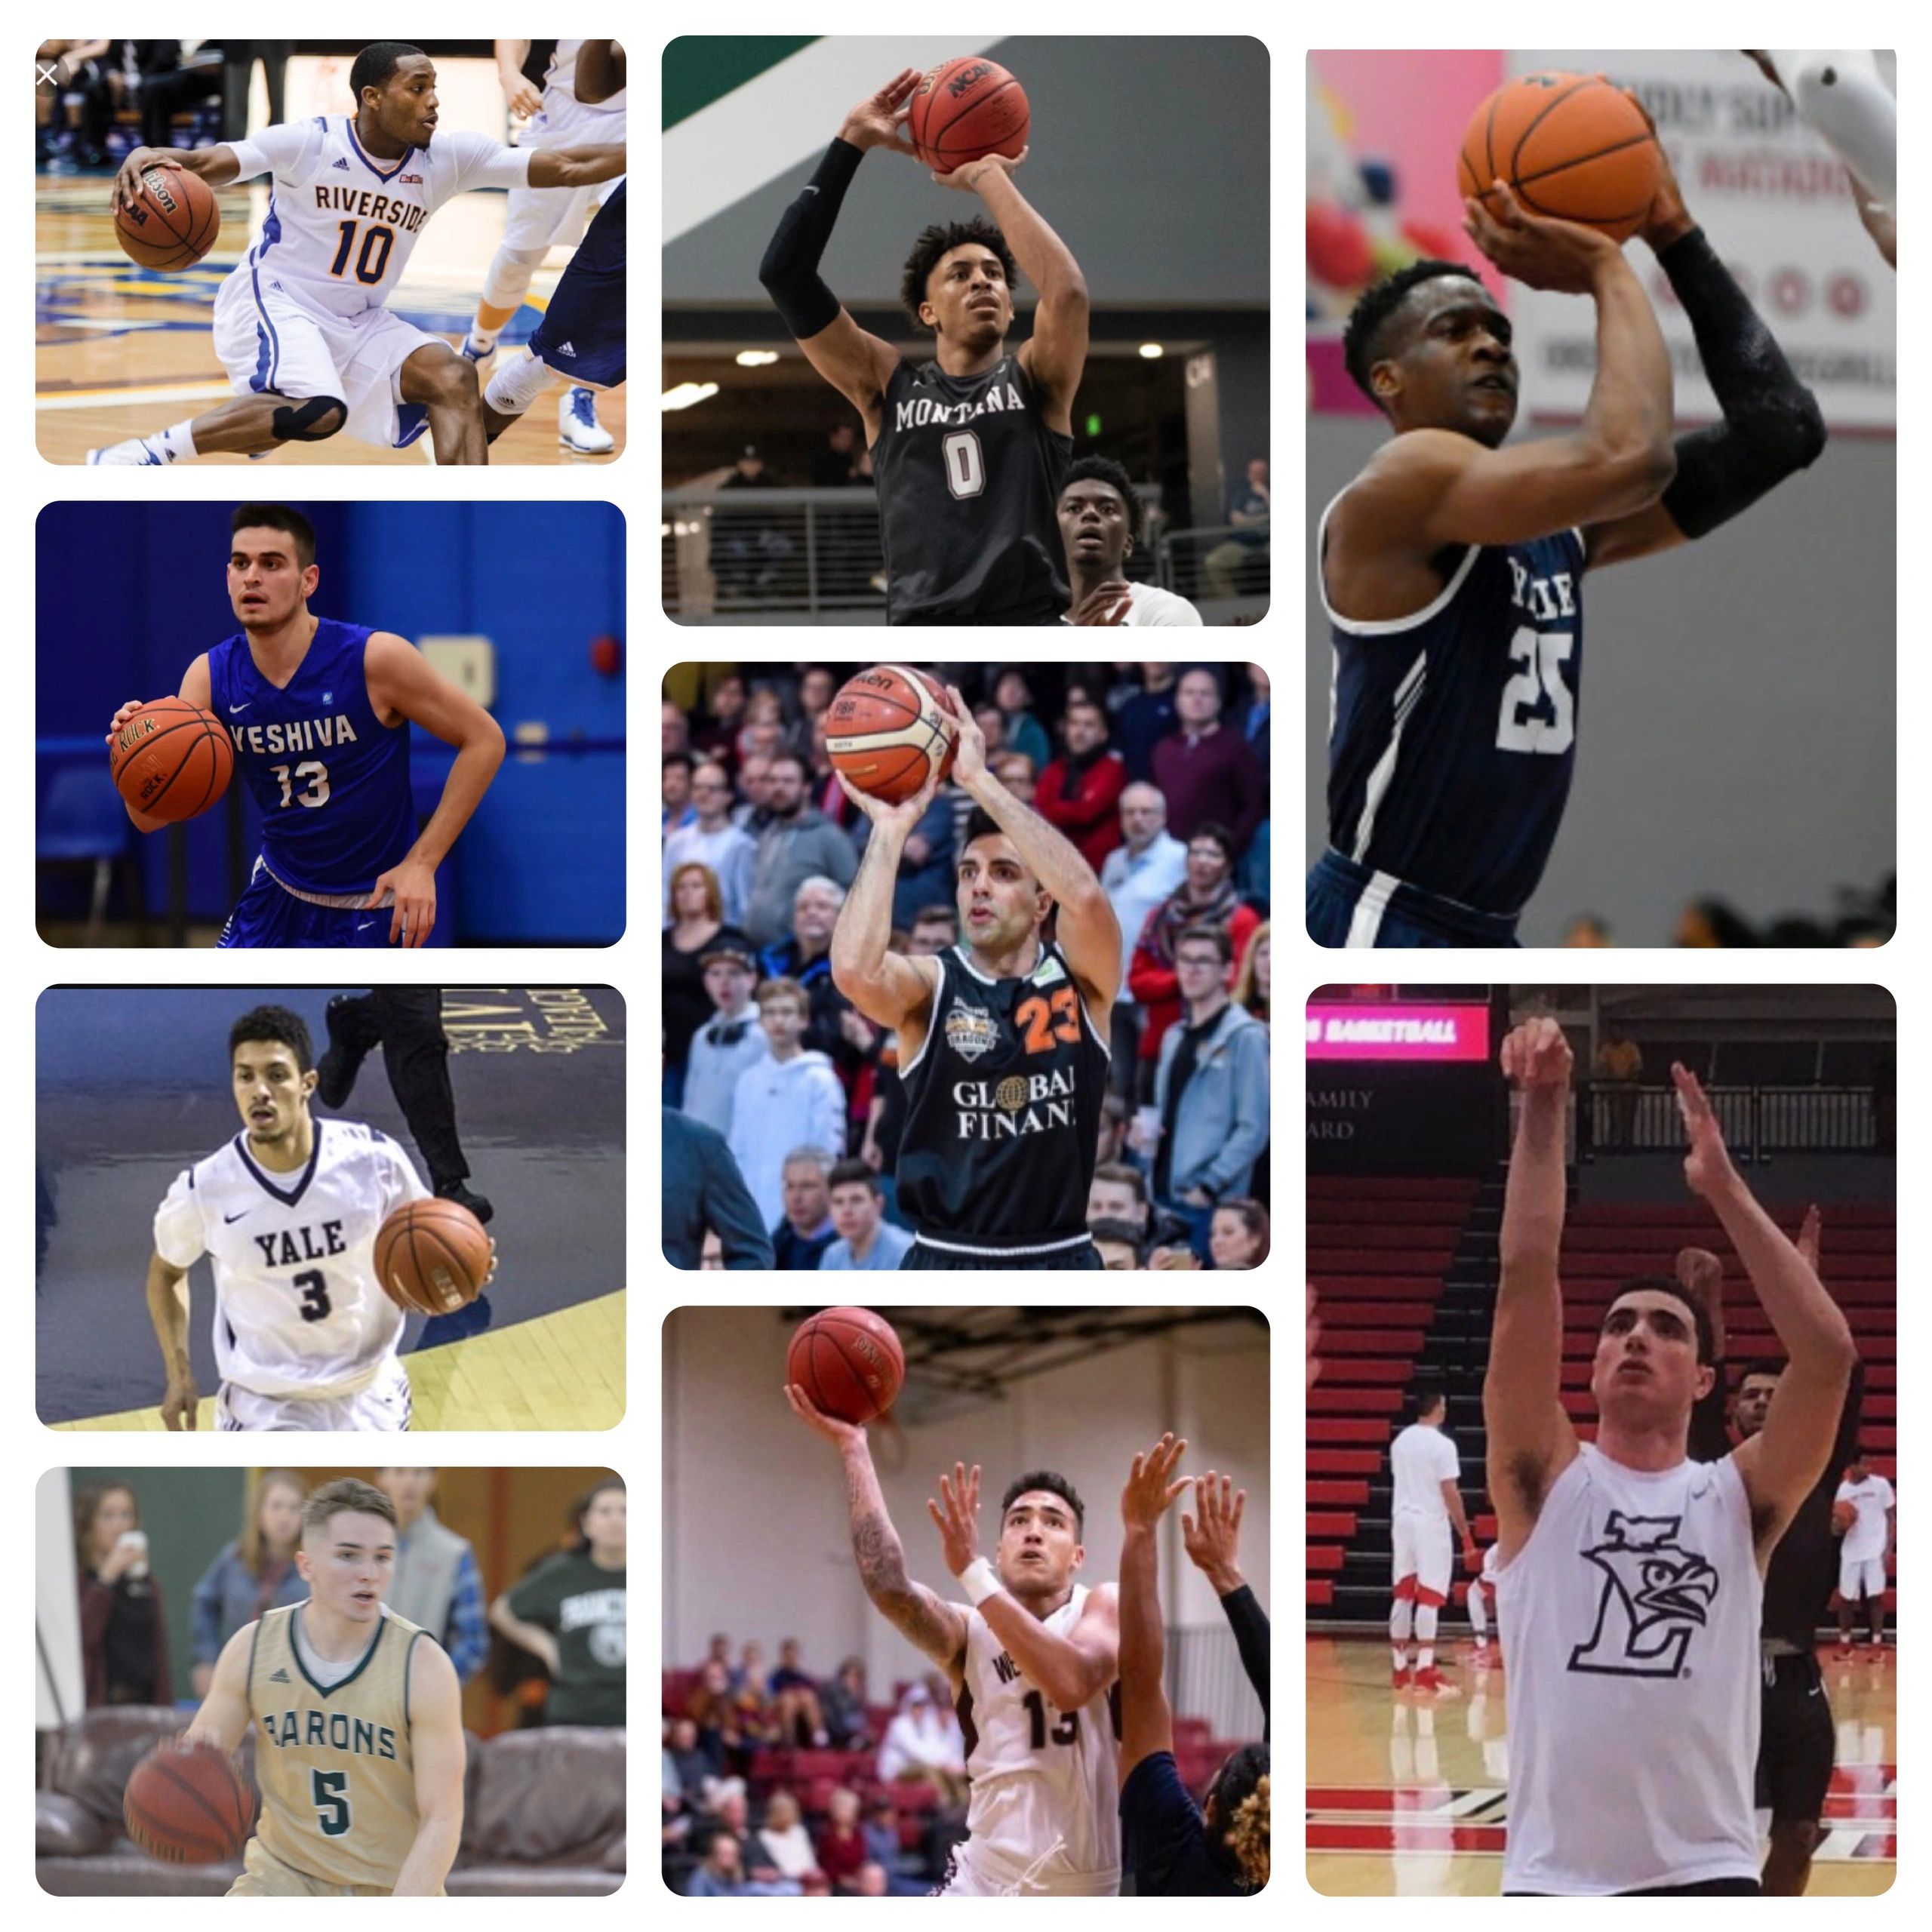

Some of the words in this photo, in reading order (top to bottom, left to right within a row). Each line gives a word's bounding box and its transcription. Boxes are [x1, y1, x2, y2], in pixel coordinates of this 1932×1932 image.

[142, 169, 178, 216] ilson
[330, 220, 396, 286] 10
[941, 429, 986, 500] 0
[1495, 626, 1574, 755] 25
[229, 714, 358, 754] YESHIVA
[269, 761, 331, 808] 13
[1014, 985, 1081, 1054] 23
[1325, 1019, 1457, 1043] BASKETBALL
[255, 1220, 346, 1267] YALE
[293, 1269, 332, 1321] 3
[310, 1766, 352, 1837] 5
